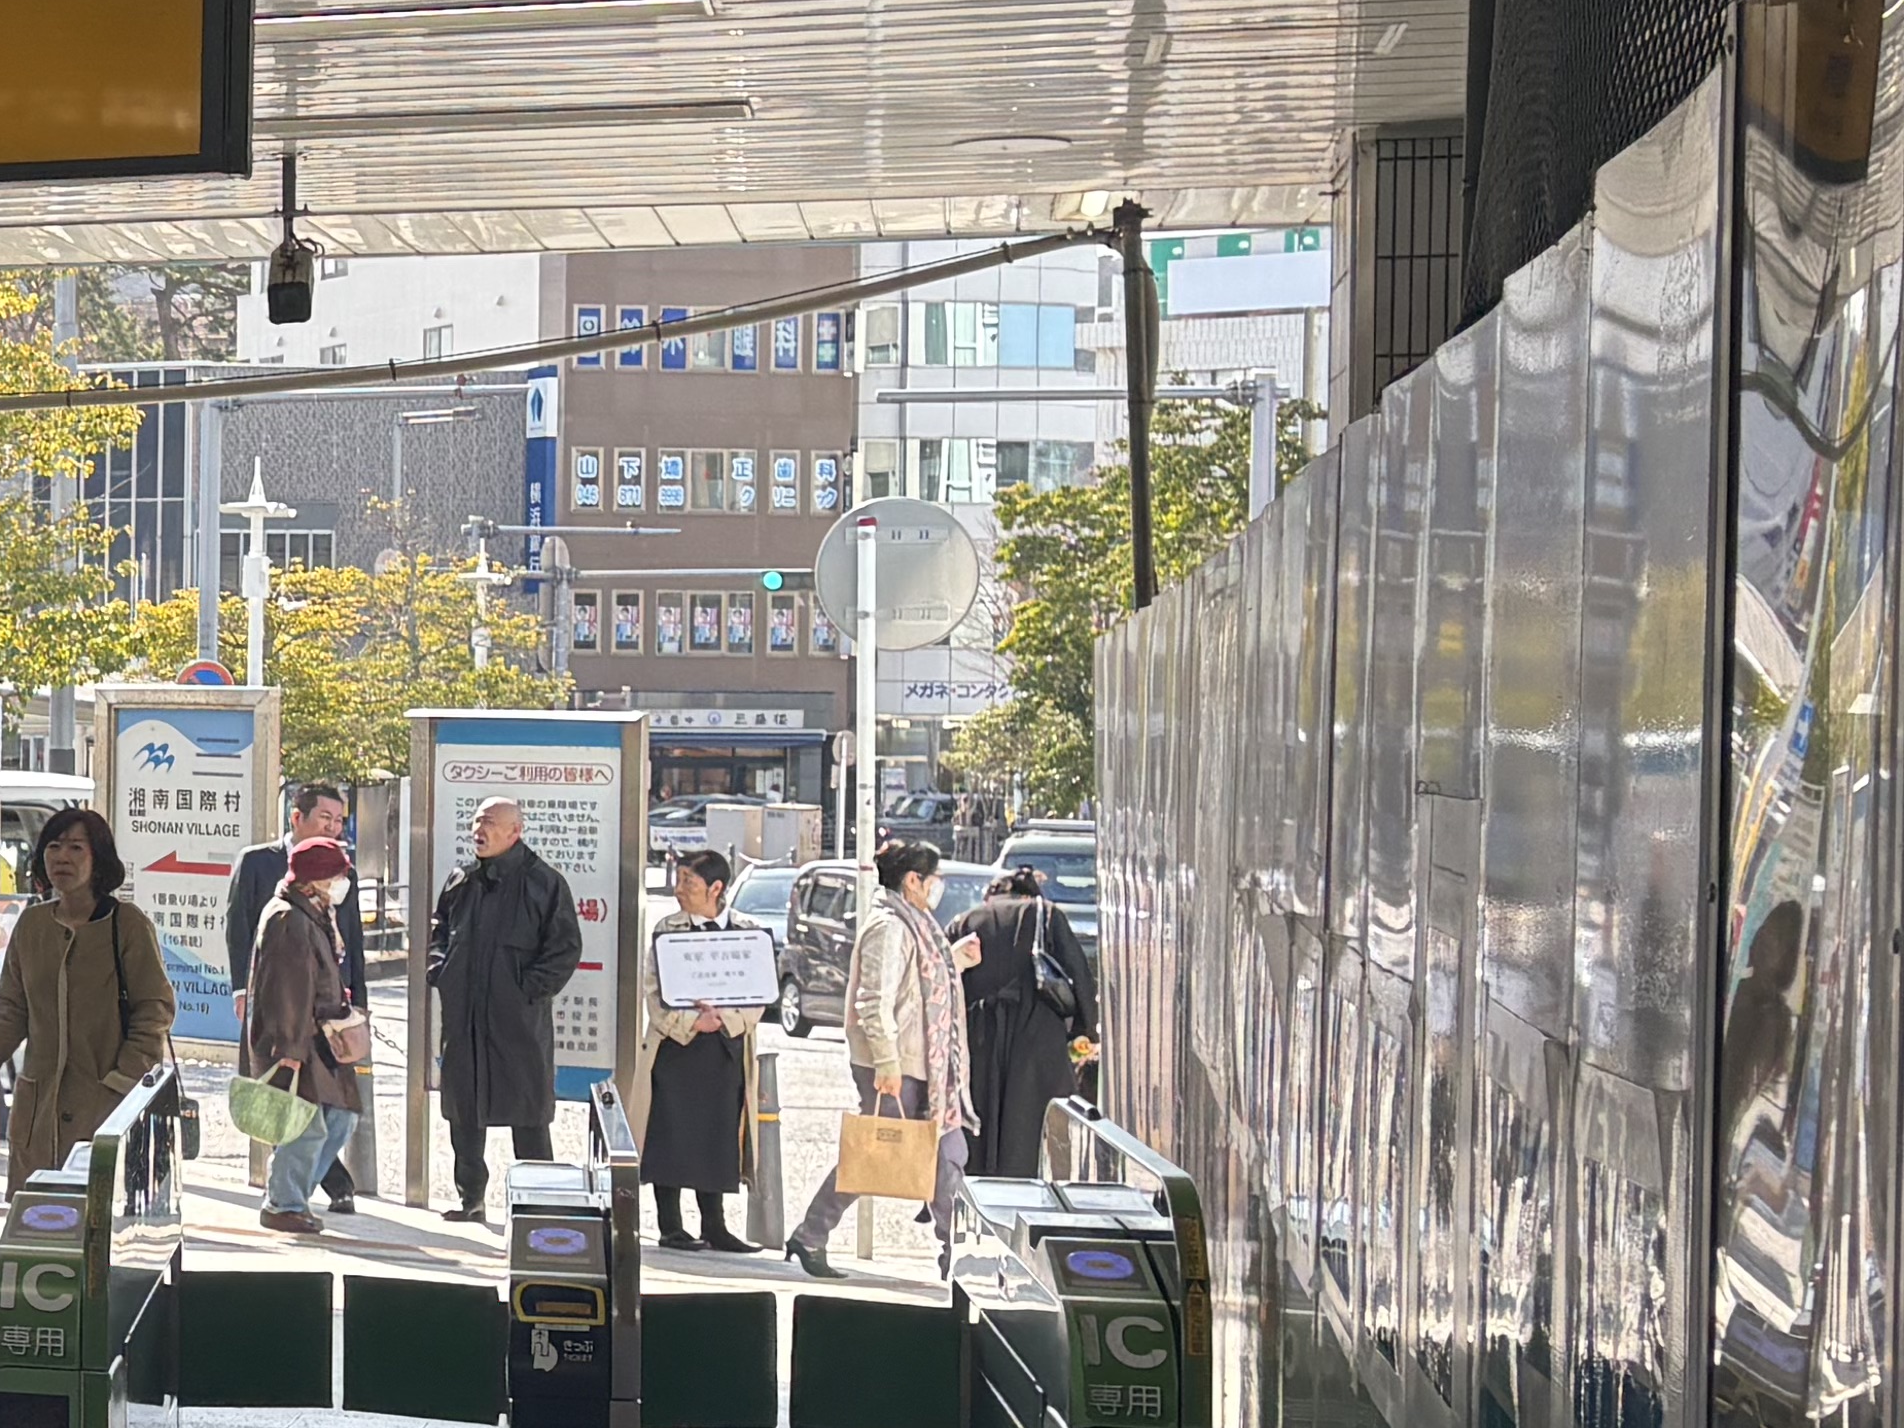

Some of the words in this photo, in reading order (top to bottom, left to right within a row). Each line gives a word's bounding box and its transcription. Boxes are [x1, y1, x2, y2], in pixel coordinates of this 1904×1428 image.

[449, 764, 610, 783] タクシーご利用の皆様へ
[128, 786, 241, 813] 湘南国際村
[131, 819, 184, 836] SHONAN
[186, 822, 241, 838] VILLAGE
[0, 1261, 77, 1312] IC
[0, 1324, 65, 1359] 専用
[1081, 1311, 1169, 1369] IC
[1086, 1383, 1164, 1419] 専用
